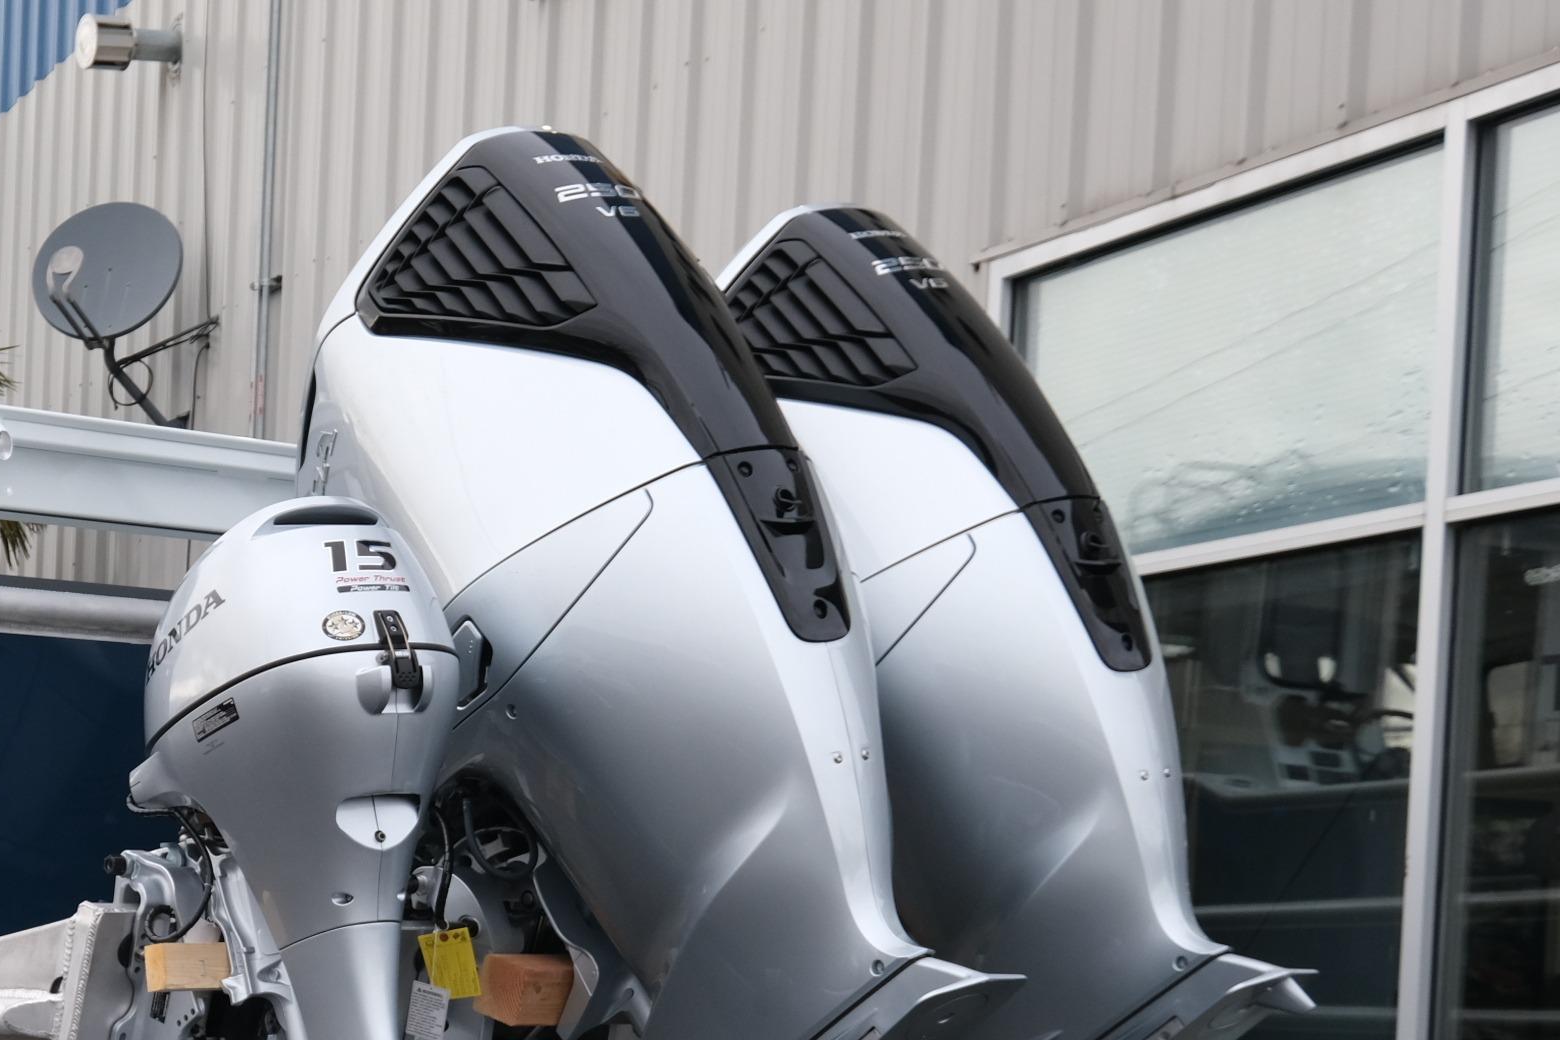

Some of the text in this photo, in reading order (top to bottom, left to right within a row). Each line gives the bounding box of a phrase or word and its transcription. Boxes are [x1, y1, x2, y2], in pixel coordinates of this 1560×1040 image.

[553, 182, 641, 203] 250
[595, 205, 640, 217] V6
[323, 540, 397, 573] 15
[336, 574, 406, 584] Power Thrust
[145, 589, 225, 686] HONDA
